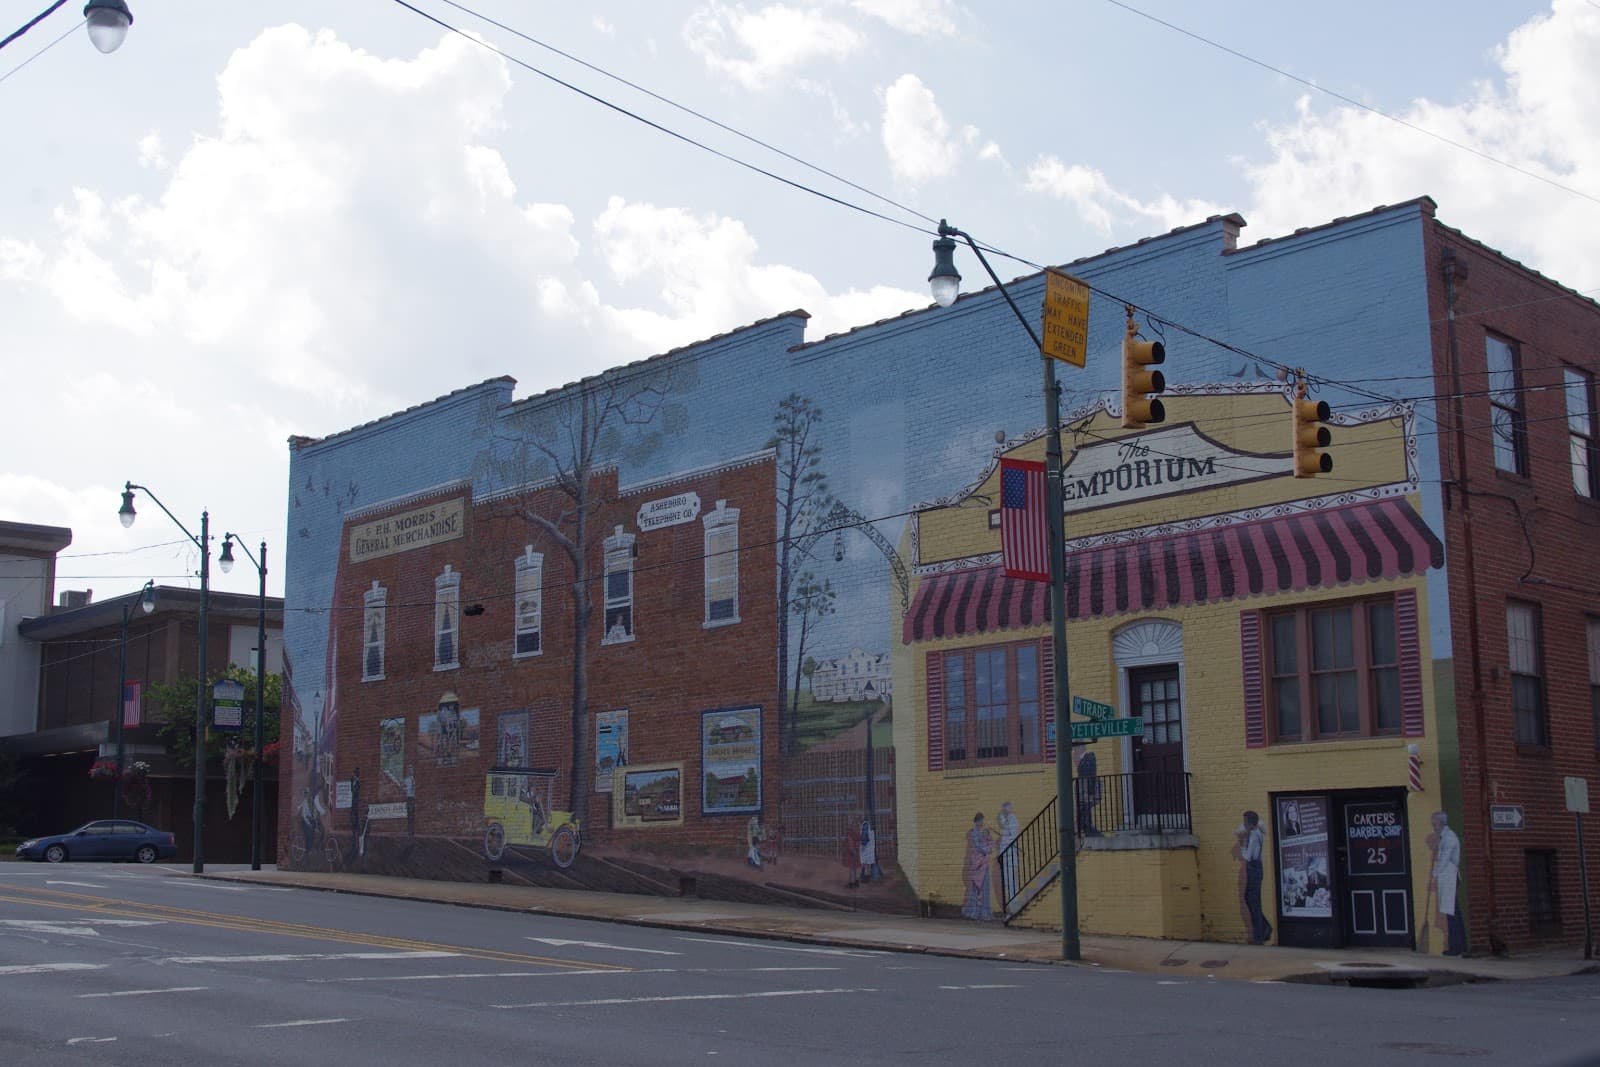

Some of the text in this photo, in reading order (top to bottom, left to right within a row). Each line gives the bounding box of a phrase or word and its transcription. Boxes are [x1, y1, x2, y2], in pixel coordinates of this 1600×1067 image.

[1053, 291, 1082, 312] TRAFFIC
[1047, 305, 1086, 330] MAY HAVE
[1047, 322, 1083, 345] EXTENDED
[1053, 341, 1076, 358] GREEN
[1118, 438, 1150, 463] The
[1063, 456, 1217, 501] EMPORIUM
[395, 511, 436, 531] MORRIS
[355, 513, 458, 555] GENERAL MERCHANDISE
[1082, 700, 1107, 720] TRADE
[1070, 720, 1129, 737] YETTEVILLE
[1350, 825, 1401, 840] BARBER SHOP
[1367, 847, 1387, 864] 25
